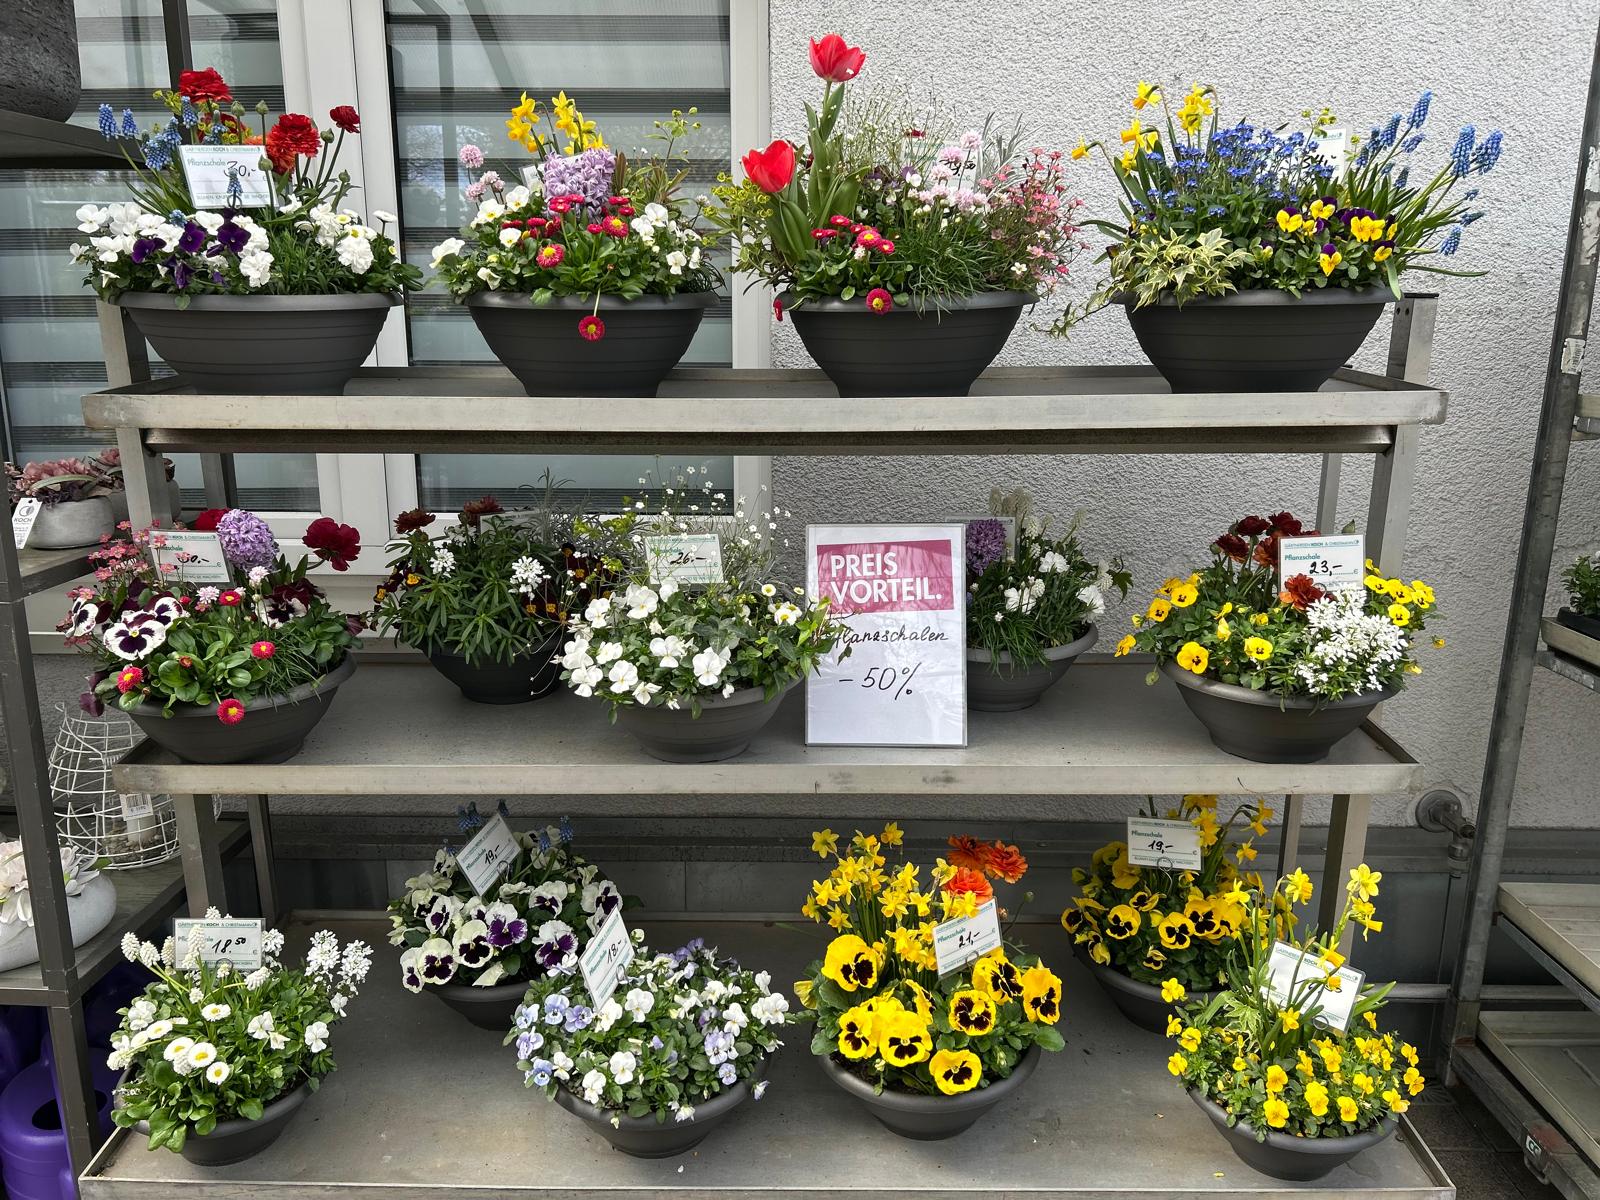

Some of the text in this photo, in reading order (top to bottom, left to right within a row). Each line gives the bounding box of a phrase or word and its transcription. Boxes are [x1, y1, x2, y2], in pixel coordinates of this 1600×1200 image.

[830, 551, 898, 578] PREIS
[1309, 560, 1343, 576] 23,-
[830, 577, 943, 605] VORTEIL.
[835, 624, 949, 648] flanzschalen
